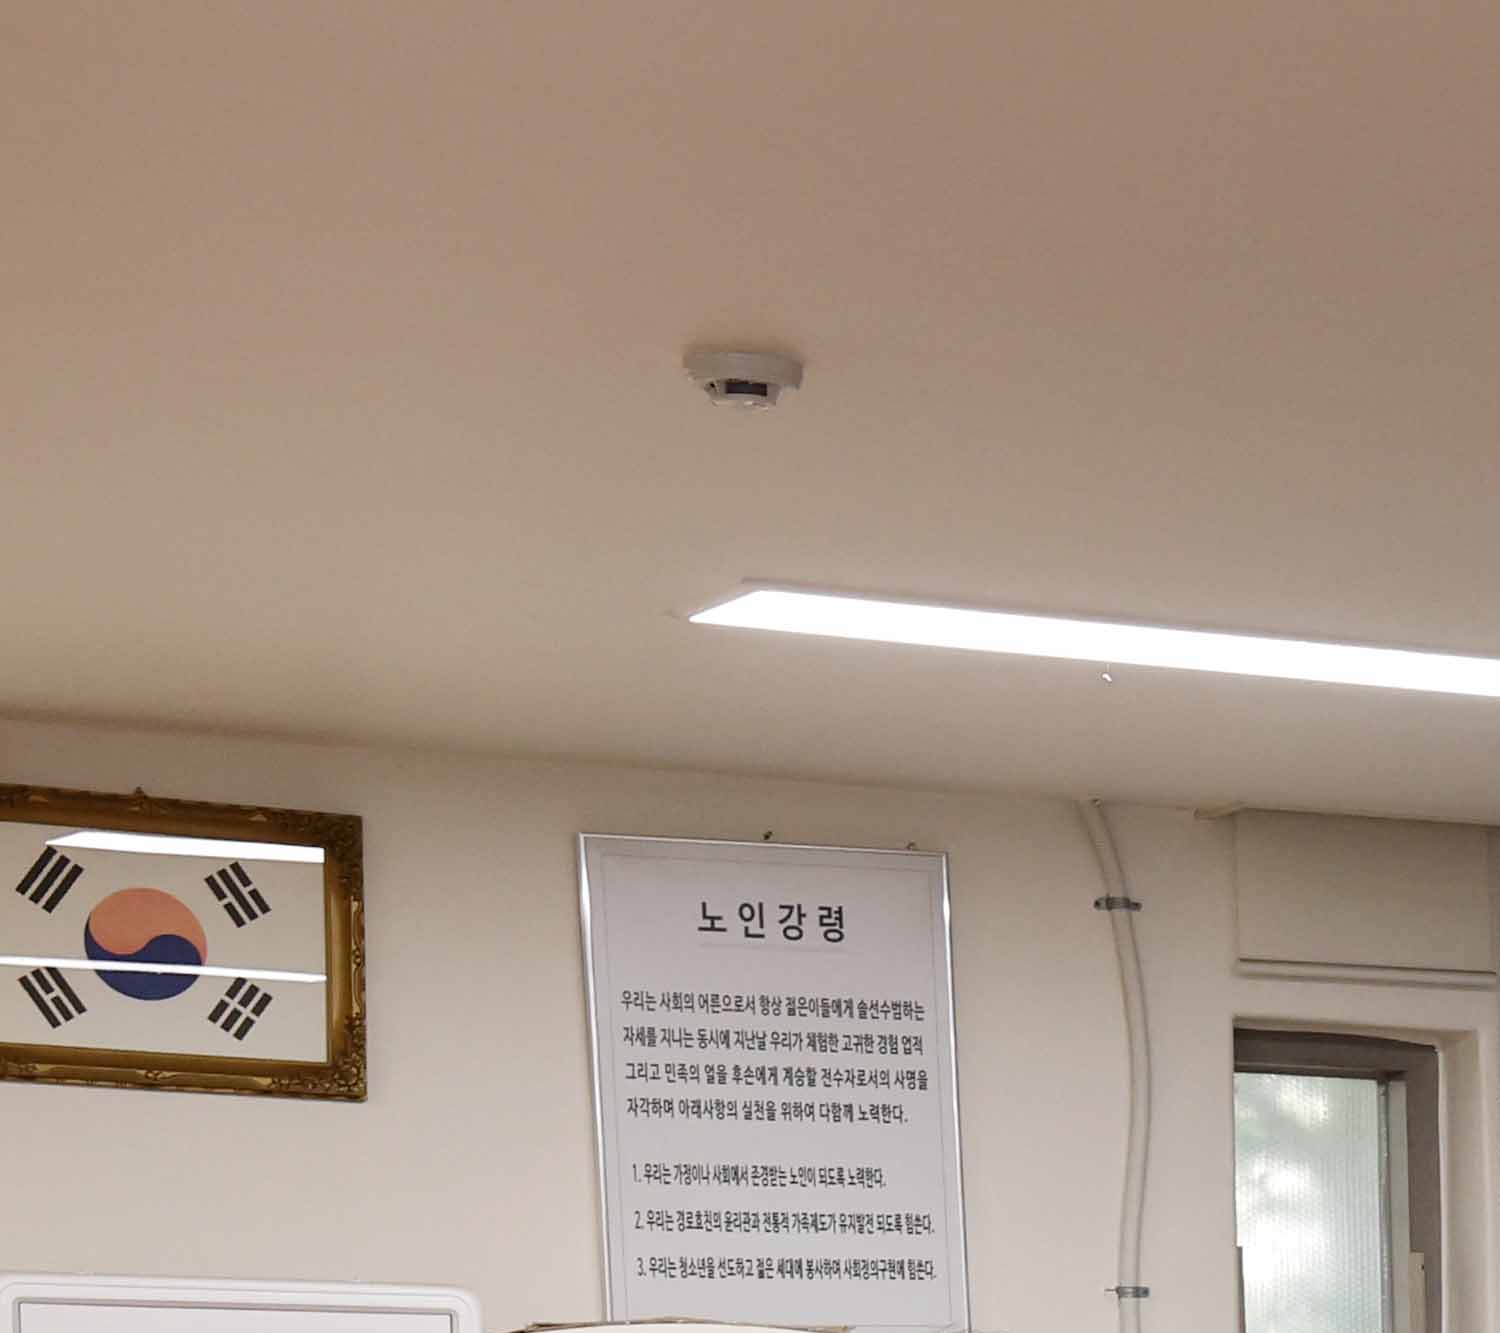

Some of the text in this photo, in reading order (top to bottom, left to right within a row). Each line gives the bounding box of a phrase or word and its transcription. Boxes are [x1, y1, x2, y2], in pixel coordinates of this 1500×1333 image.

[621, 991, 924, 1021] 우리는 사회의 어른으로서 항상 젊은이들에게 솔선수범하는
[626, 1063, 928, 1090] 그리고 민족의 얼을 후손에게 계승할 전수자로서의 사명을
[627, 1097, 907, 1124] 자각하며 아래사항의 실천을 위하여 다함께 노력한다.
